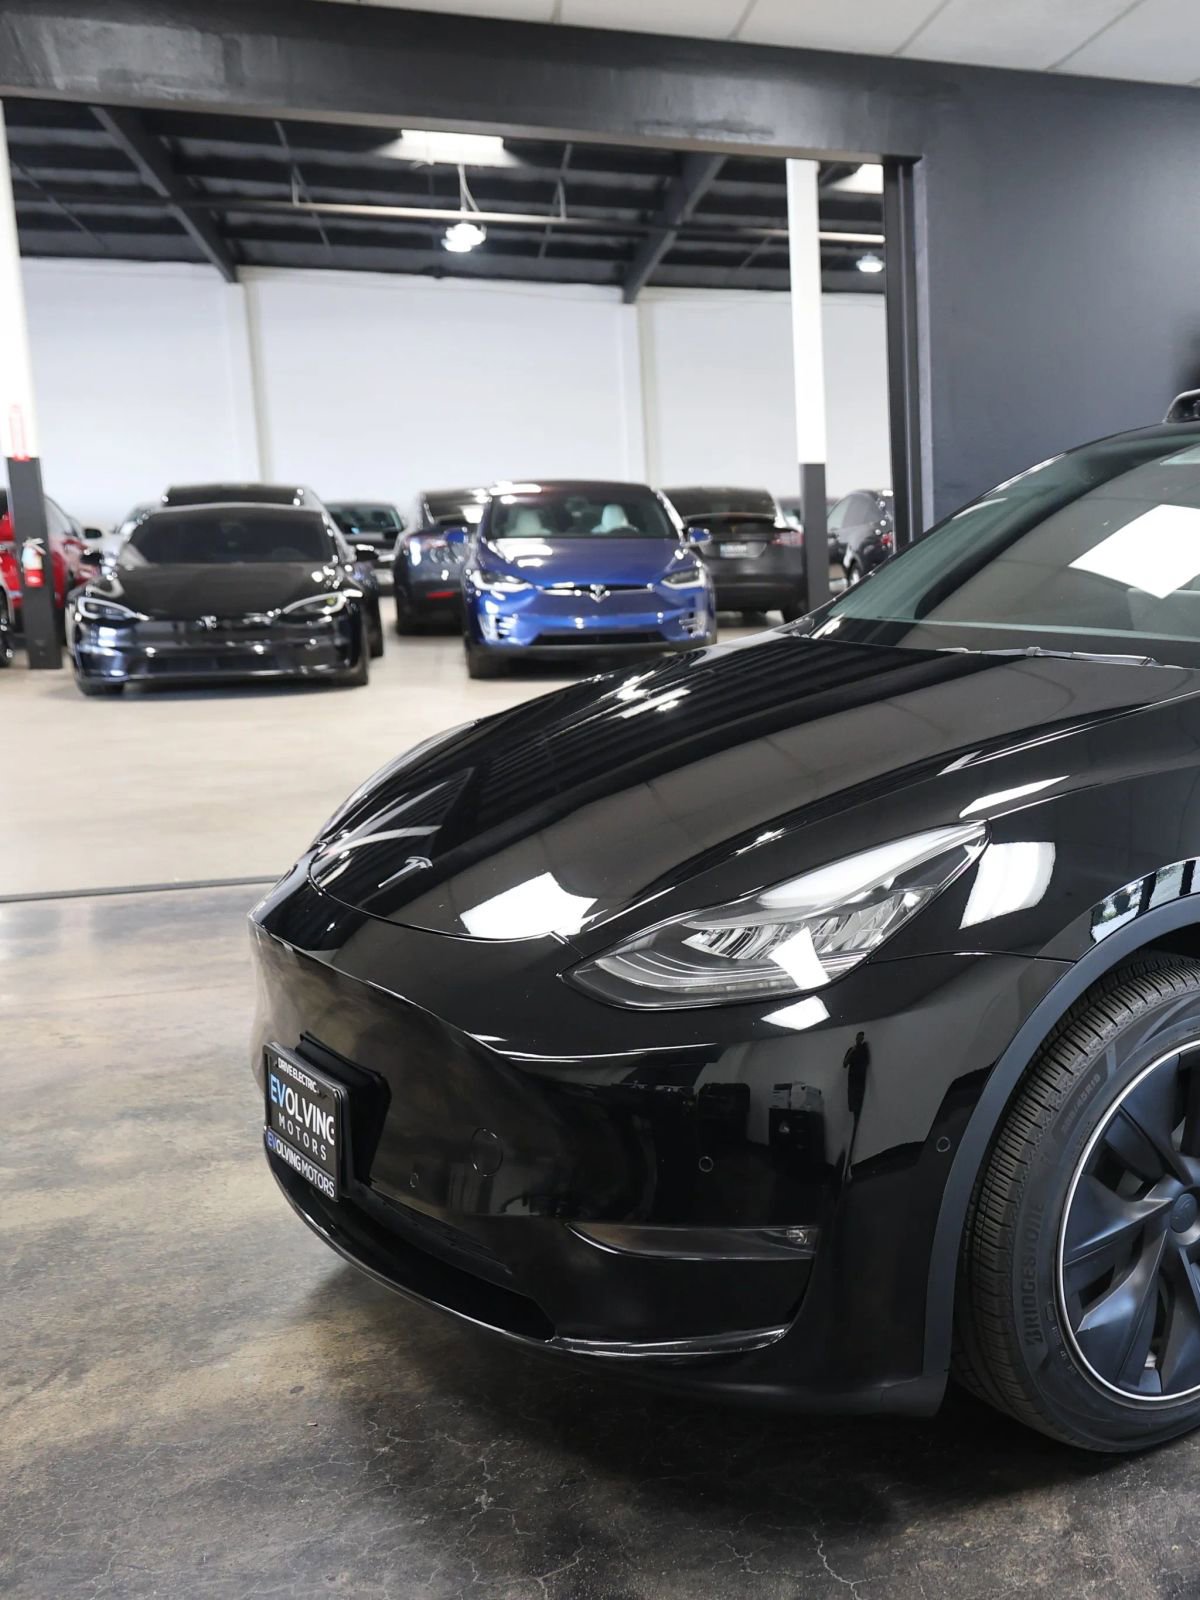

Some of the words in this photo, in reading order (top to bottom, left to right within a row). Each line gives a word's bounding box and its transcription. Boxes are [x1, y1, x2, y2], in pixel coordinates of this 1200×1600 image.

[277, 1057, 293, 1077] DRIVE
[270, 1073, 335, 1146] EVOLVING
[278, 1112, 327, 1161] MOTORS
[266, 1131, 302, 1172] EVOLVING
[301, 1159, 335, 1198] MOTORS
